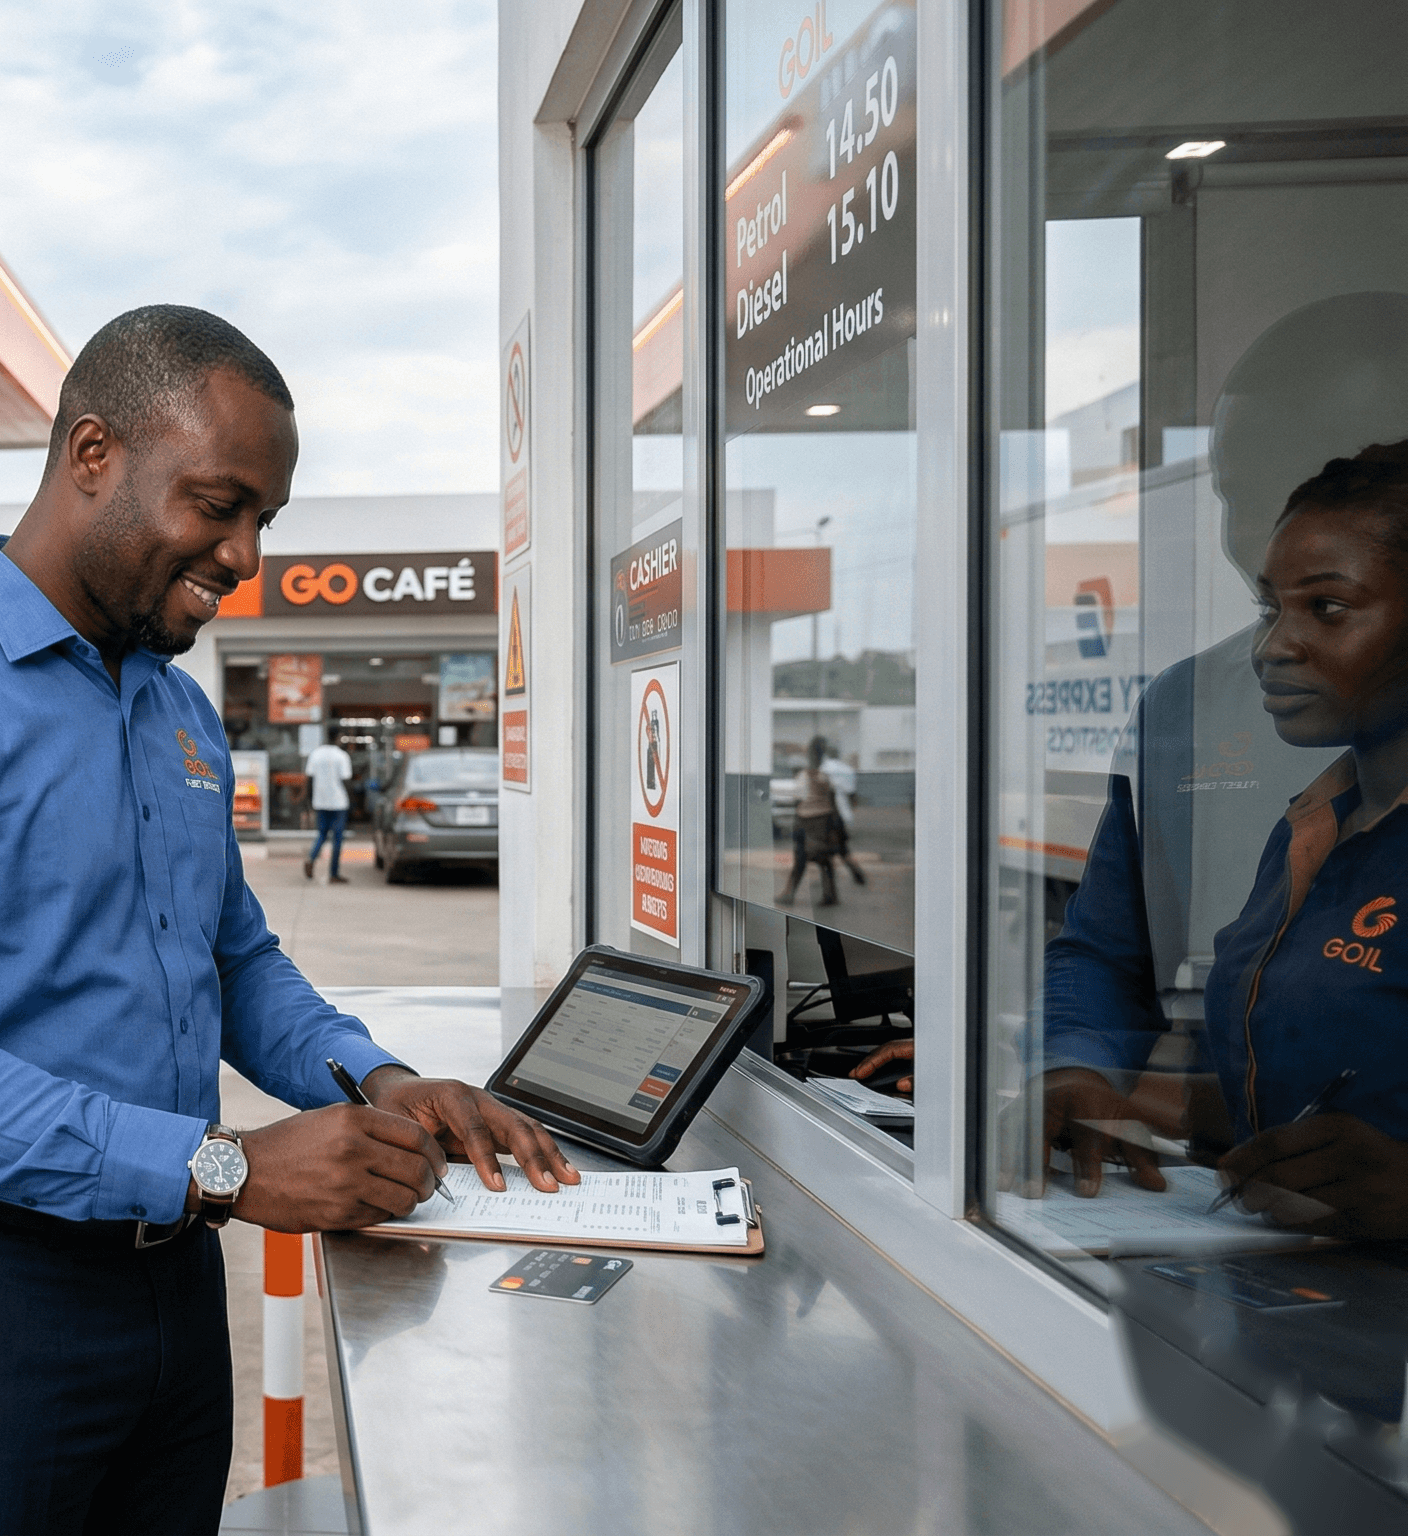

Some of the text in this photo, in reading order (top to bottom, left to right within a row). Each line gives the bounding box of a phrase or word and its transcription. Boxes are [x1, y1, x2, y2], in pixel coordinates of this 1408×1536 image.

[779, 0, 833, 99] GOIL
[737, 55, 898, 268] Petrol 14.50
[737, 150, 899, 340] Diesel 15.10
[745, 287, 884, 410] Operational Hours
[281, 558, 476, 605] GO CAFÉ
[630, 538, 678, 591] CASHIER
[1322, 938, 1383, 973] GOIL
